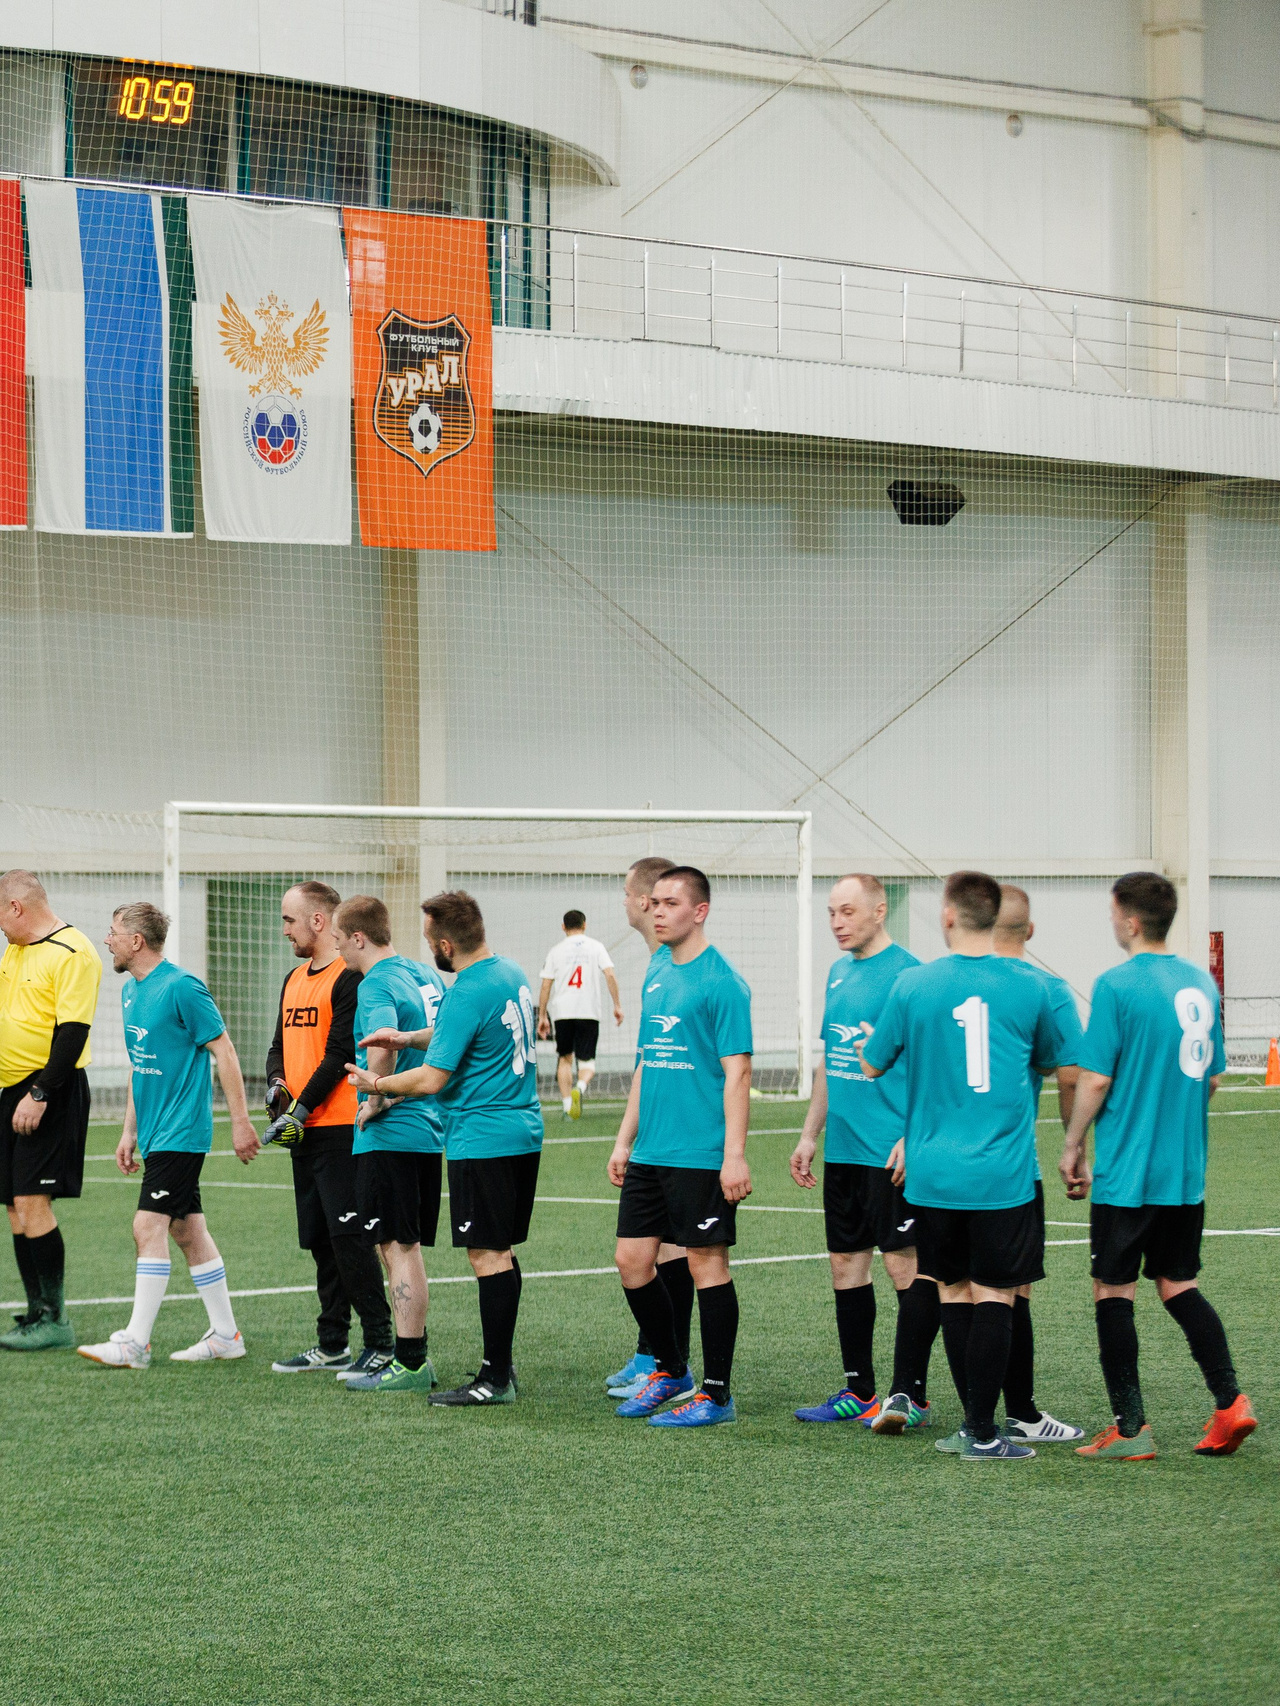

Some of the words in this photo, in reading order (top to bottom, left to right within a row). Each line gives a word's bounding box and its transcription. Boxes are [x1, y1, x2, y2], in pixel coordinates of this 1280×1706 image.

[389, 333, 460, 347] ФУТБОЛЬНЫЙ
[411, 343, 438, 353] КЛУБ
[387, 355, 460, 407] УРАЛ
[243, 406, 264, 469] РОССИЙСКИЙ
[264, 439, 308, 475] ФУТБОЛЬНЫЙ
[299, 408, 309, 437] СОЮЗ
[568, 965, 583, 989] 4
[952, 995, 991, 1093] 1
[1174, 987, 1216, 1082] 8
